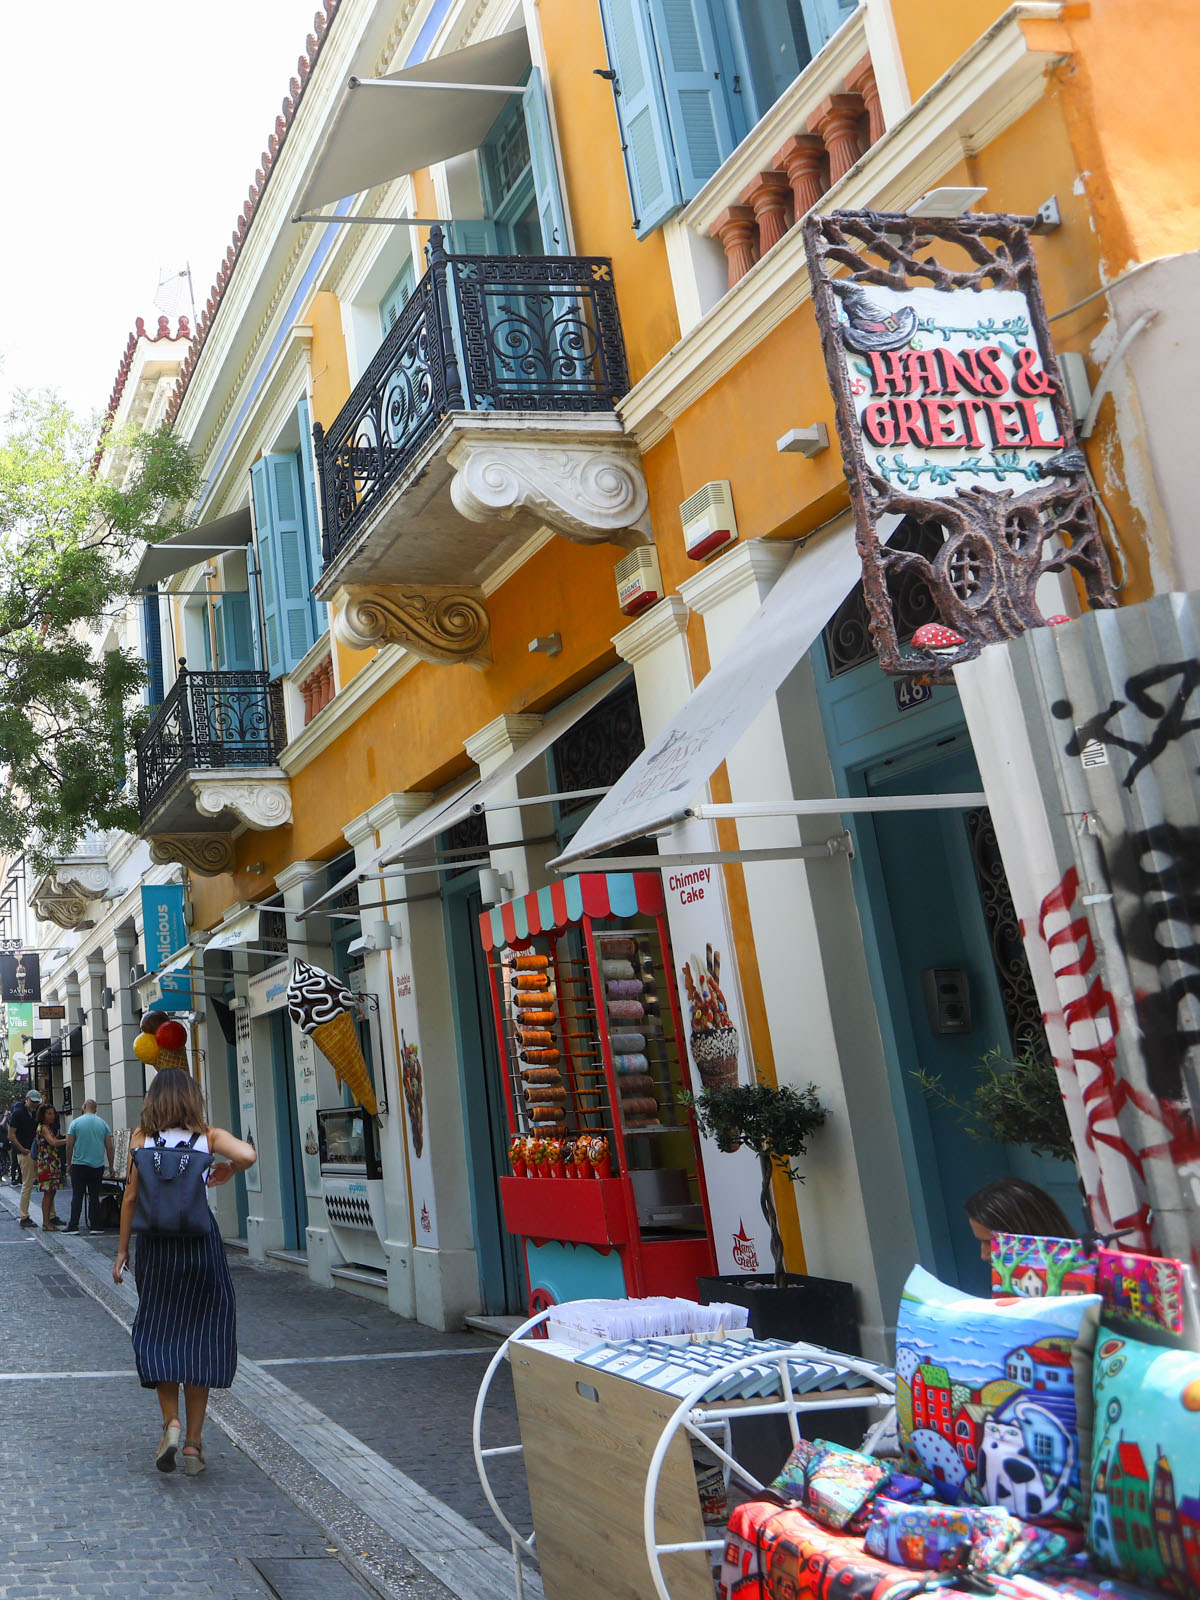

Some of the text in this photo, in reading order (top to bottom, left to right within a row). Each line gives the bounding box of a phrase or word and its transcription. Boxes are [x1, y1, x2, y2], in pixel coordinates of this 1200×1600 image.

[868, 346, 1057, 397] HANS &
[862, 398, 1065, 449] GRETEL
[900, 676, 923, 704] 48
[669, 867, 710, 891] Chimney
[680, 887, 704, 905] Cake
